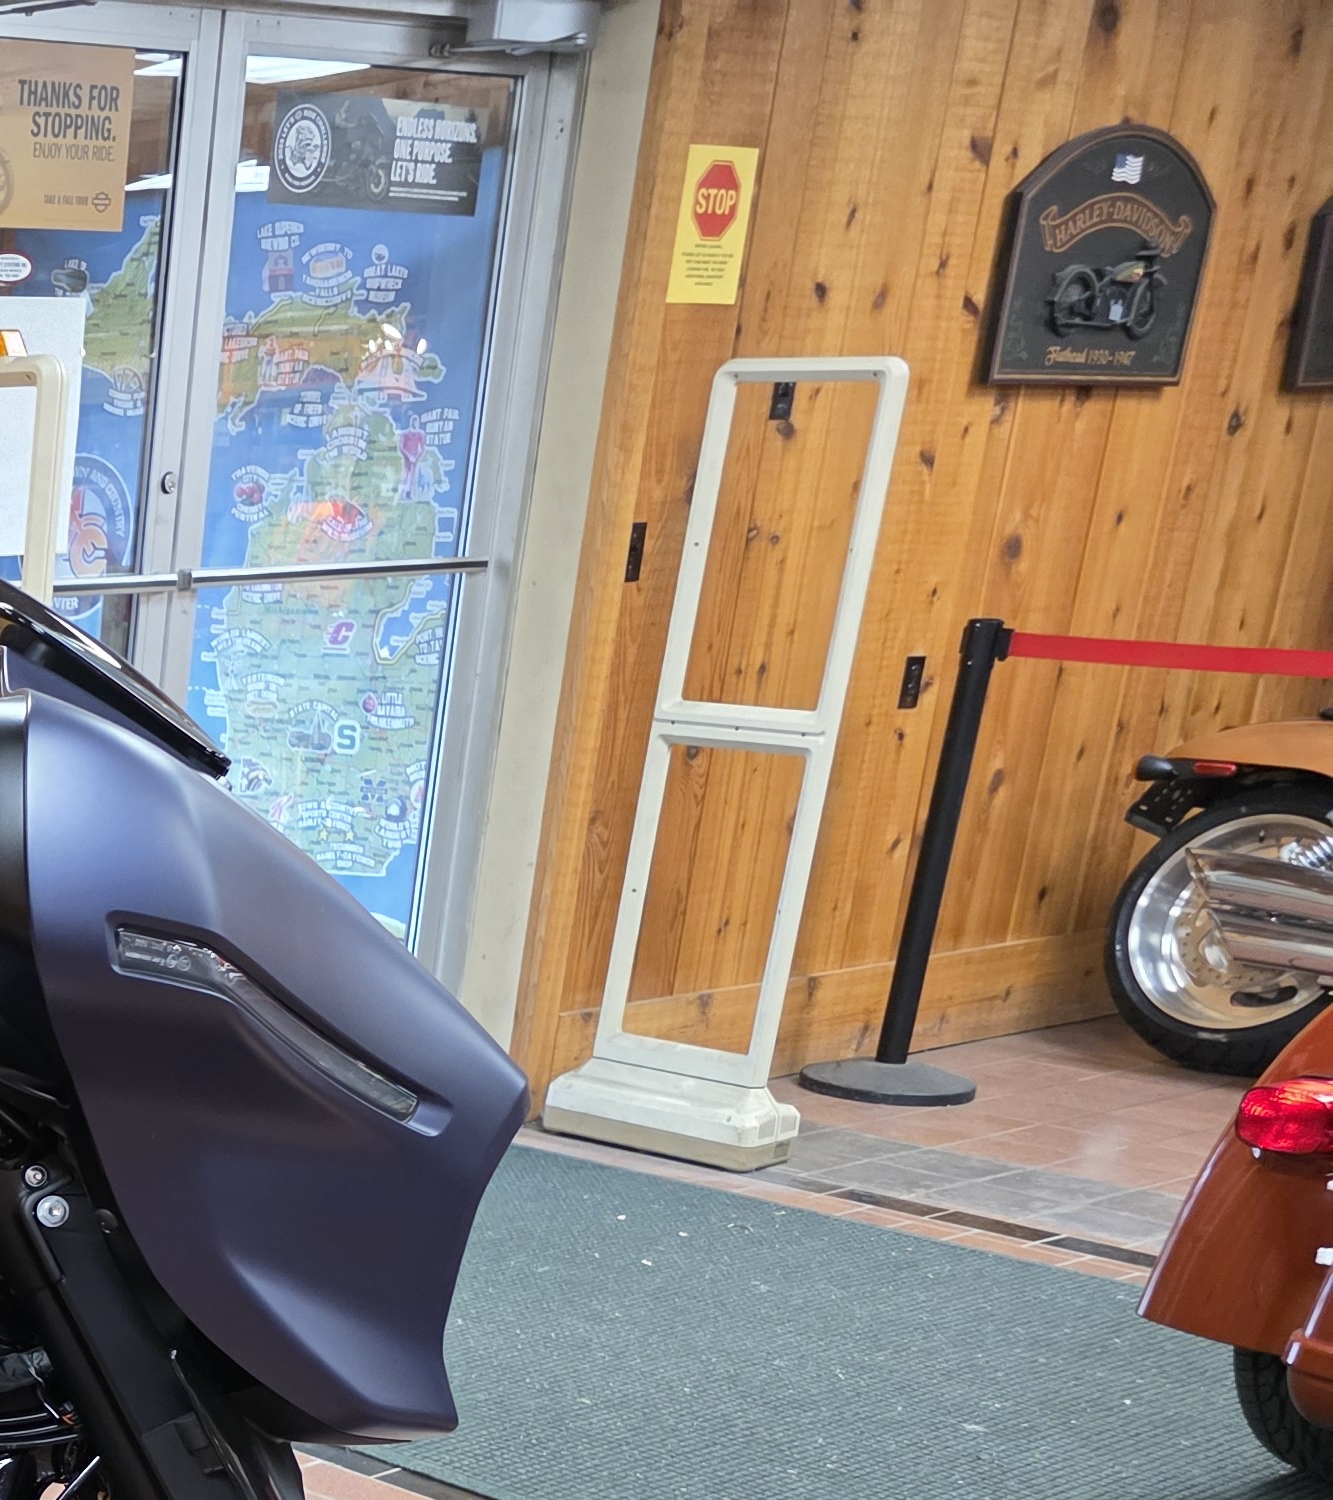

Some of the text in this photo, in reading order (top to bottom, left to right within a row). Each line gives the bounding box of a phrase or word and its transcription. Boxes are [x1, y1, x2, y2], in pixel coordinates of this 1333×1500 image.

[18, 79, 120, 112] THANKS FOR
[30, 111, 116, 142] STOPPING.
[33, 142, 62, 159] ENJOY
[64, 143, 90, 161] YOUR
[695, 187, 737, 215] STOP
[1055, 201, 1177, 251] HARLEY-DAVIDSON
[336, 724, 357, 750] S
